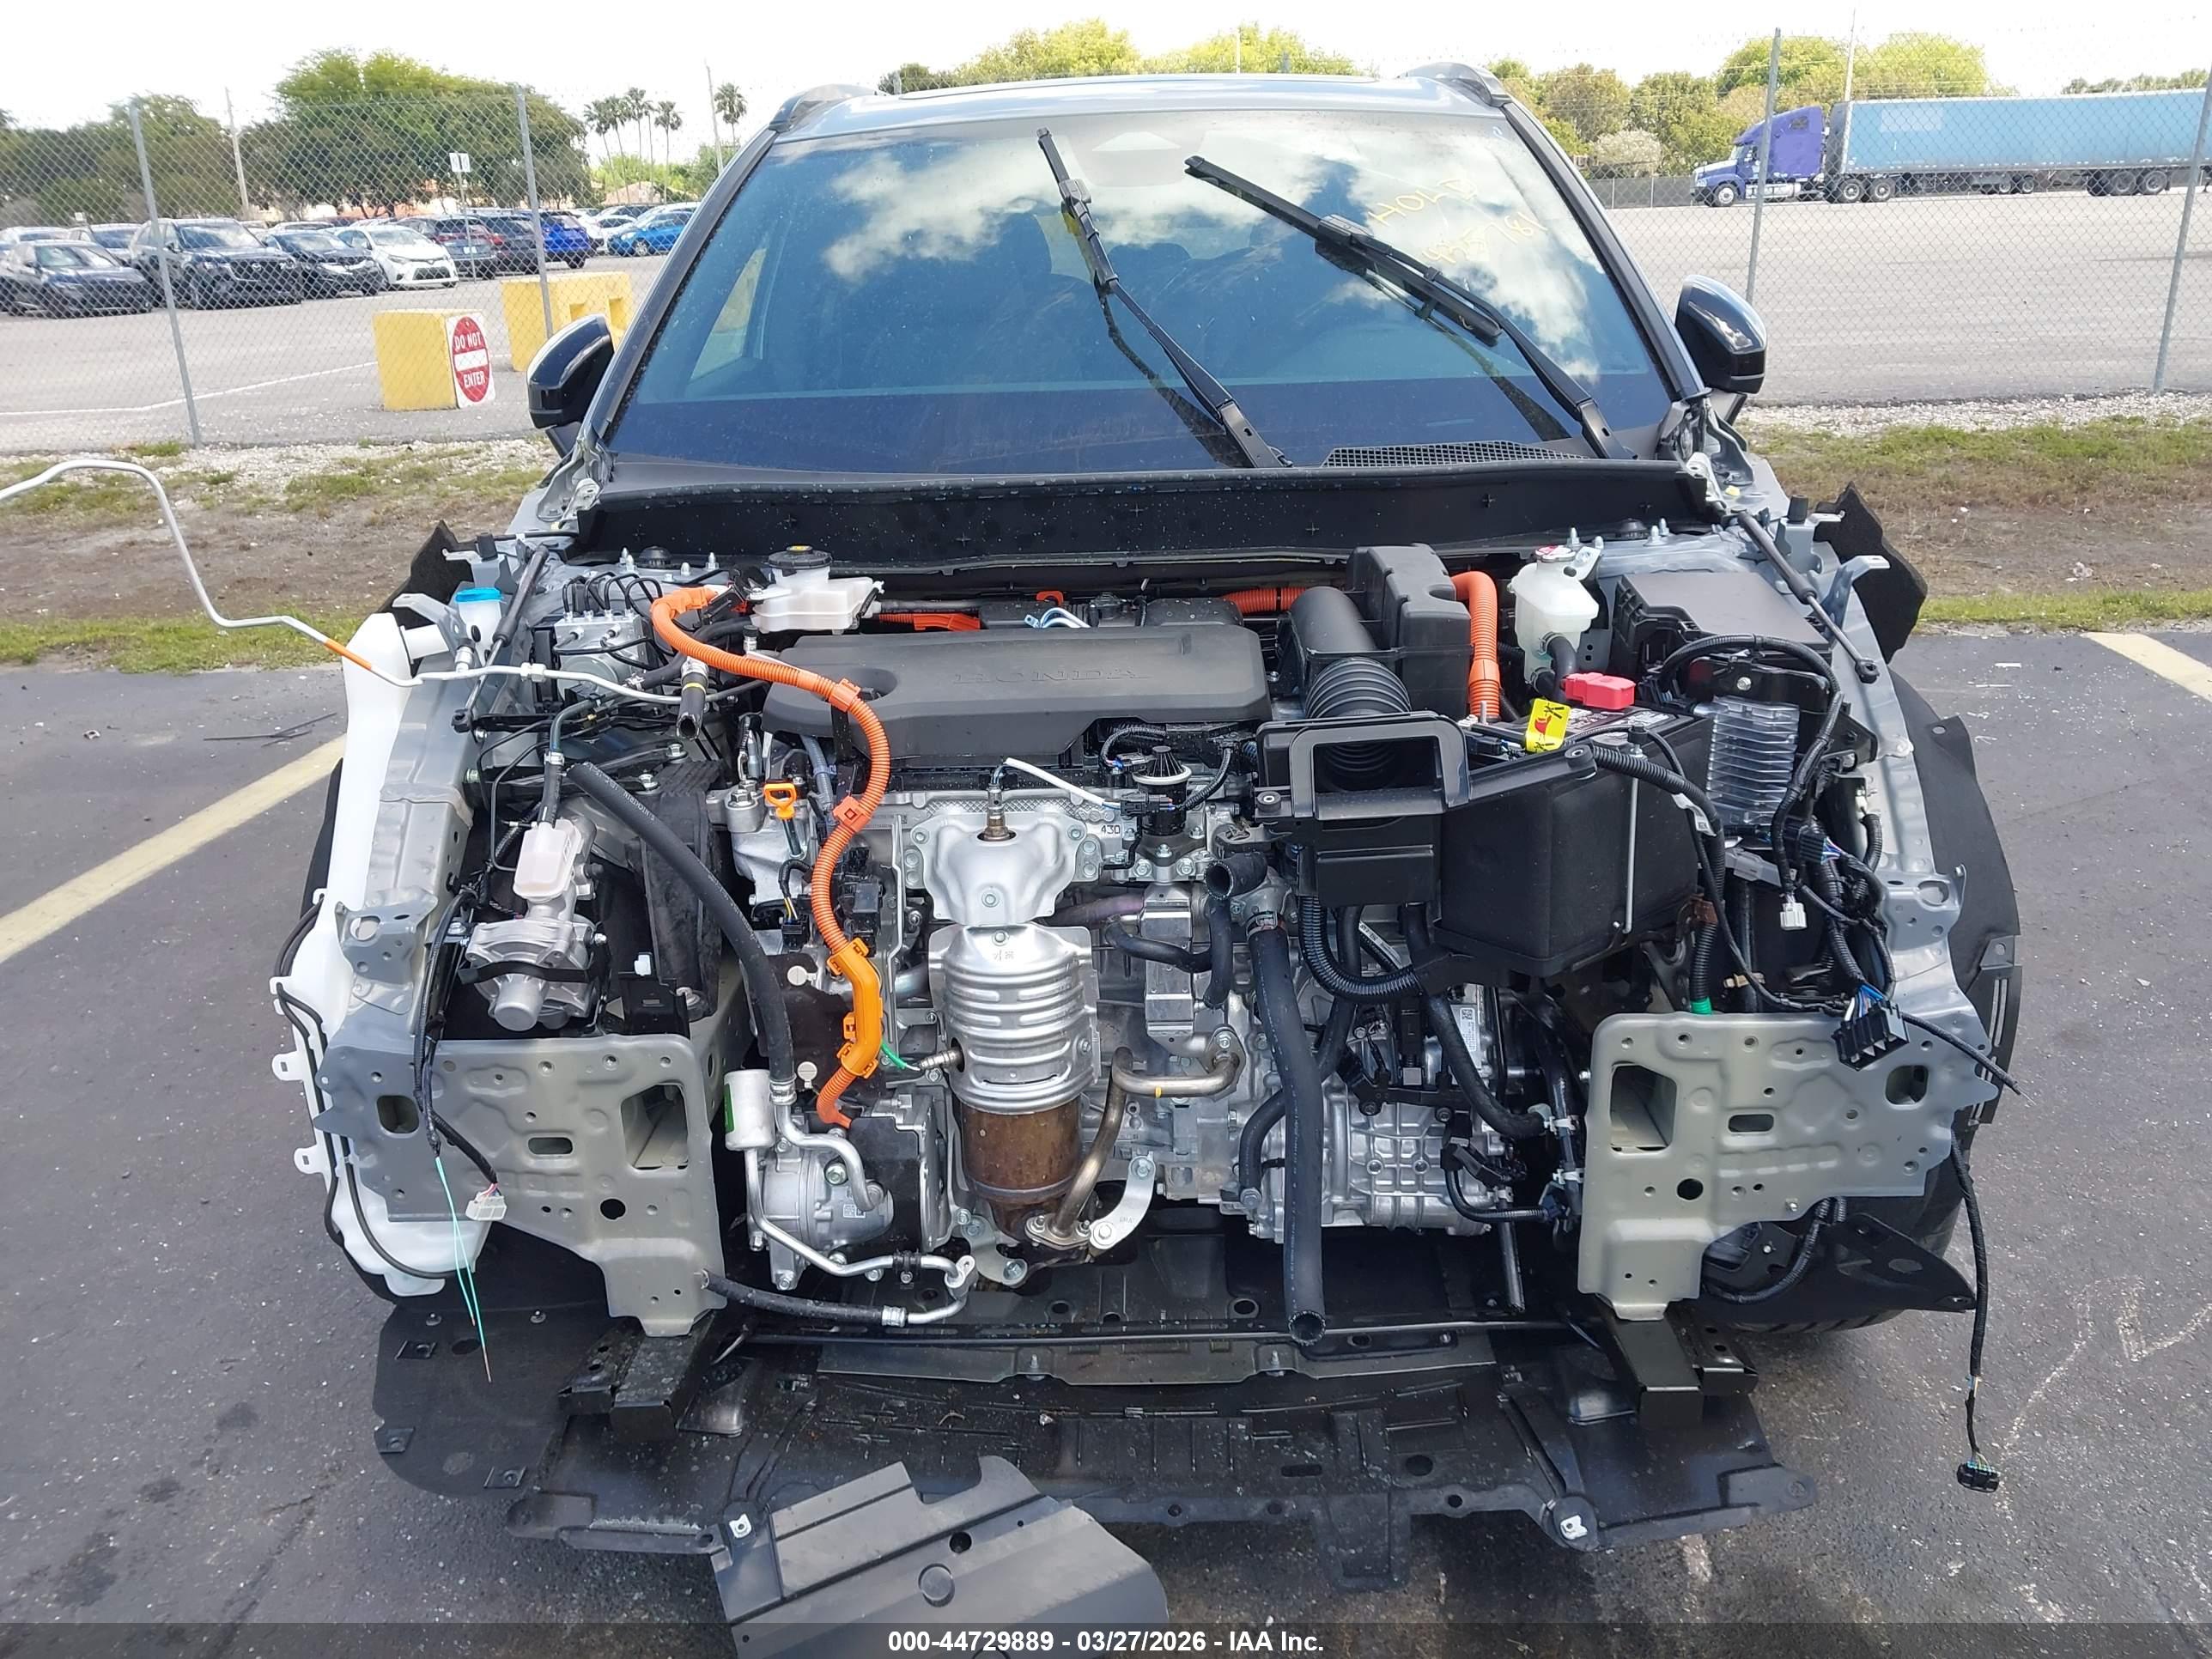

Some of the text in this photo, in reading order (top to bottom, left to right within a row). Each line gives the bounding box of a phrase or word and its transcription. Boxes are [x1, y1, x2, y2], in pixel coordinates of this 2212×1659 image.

[1368, 178, 1478, 227] HOLD
[453, 331, 482, 350] DO NOT
[464, 371, 486, 388] ENTER
[1101, 824, 1121, 835] 430
